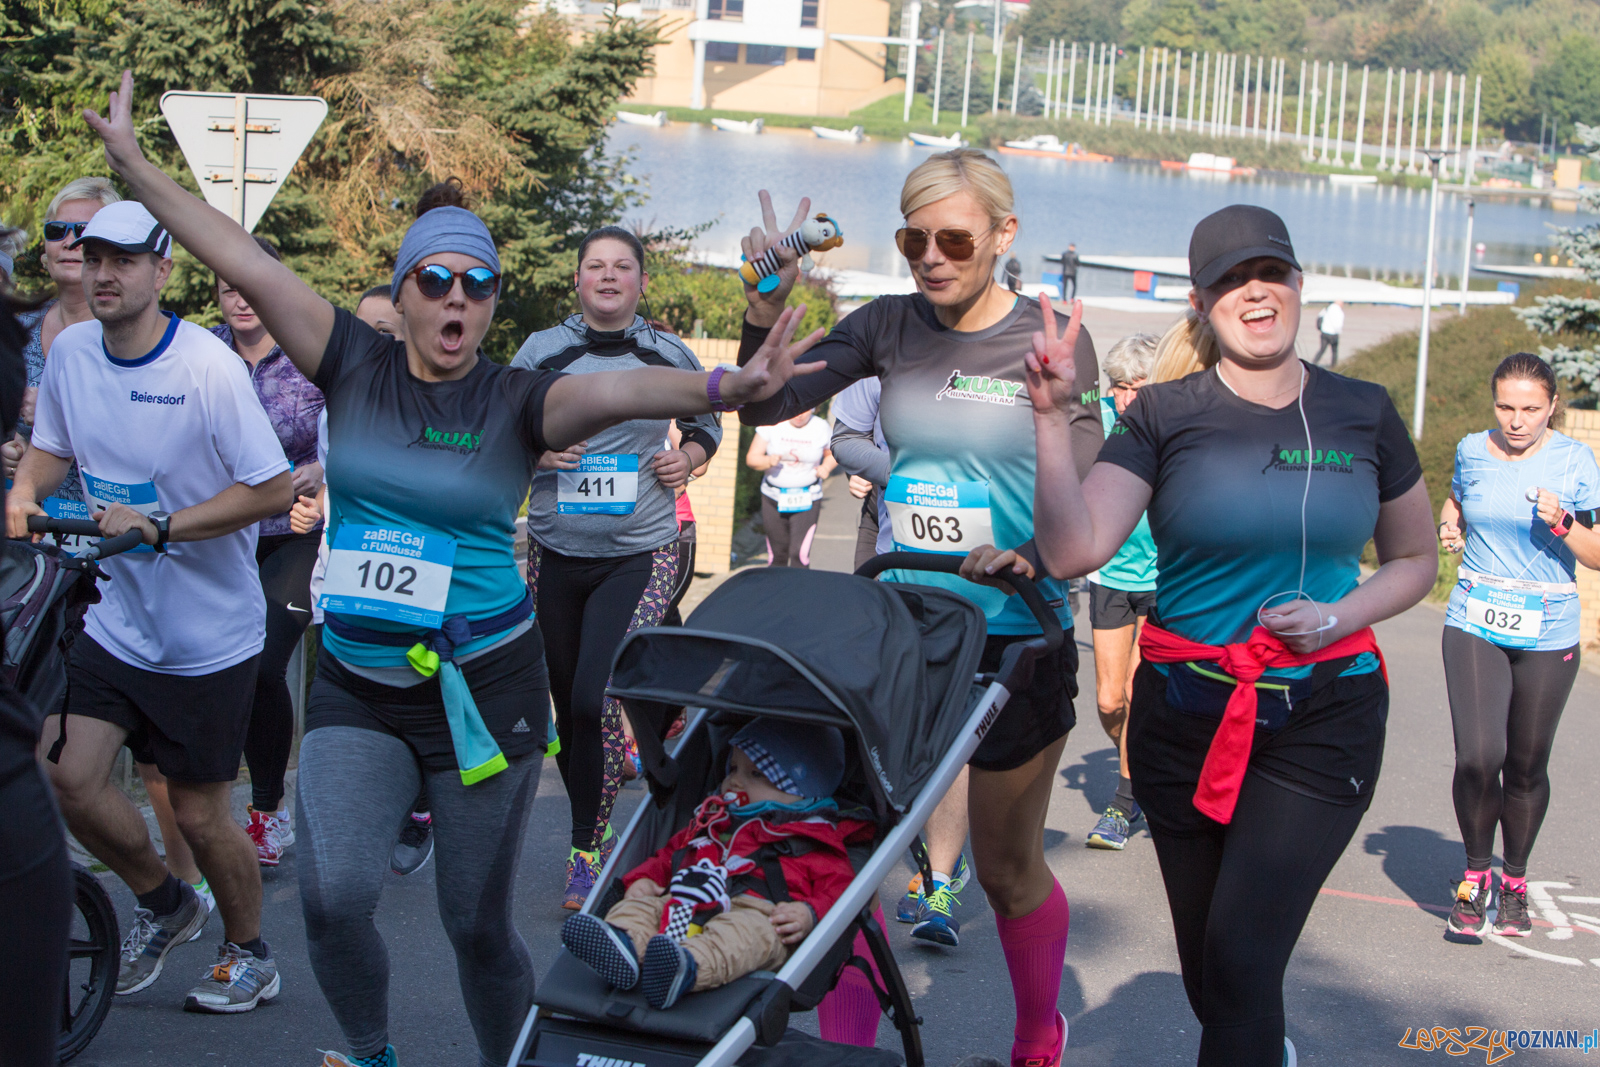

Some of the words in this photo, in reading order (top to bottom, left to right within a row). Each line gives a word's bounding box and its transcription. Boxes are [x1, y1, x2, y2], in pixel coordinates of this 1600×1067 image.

[953, 377, 1022, 398] MUAY
[130, 390, 186, 405] Beiersdorf
[950, 391, 987, 402] RUNNING
[989, 396, 1015, 405] TEAM
[1081, 388, 1100, 405] MU
[424, 427, 484, 449] MUAY
[420, 441, 457, 453] RUNNING
[1279, 449, 1355, 467] MUAY
[1328, 466, 1354, 474] TEAM
[93, 480, 130, 498] zaBIEGaj
[577, 477, 615, 497] 411
[906, 482, 958, 500] zaBIEGaj
[99, 491, 131, 504] FUNdusze
[906, 496, 912, 504] o
[913, 495, 959, 507] FUNdusze
[59, 502, 87, 512] zaBIEG
[911, 513, 963, 543] 063
[363, 529, 425, 550] zaBIEGaj
[370, 541, 422, 558] FUNdusze
[358, 560, 417, 596] 102
[1488, 590, 1526, 605] zaBIEGaj
[1493, 597, 1525, 609] FUNdusze
[1485, 608, 1522, 631] 032
[974, 701, 999, 740] THULE
